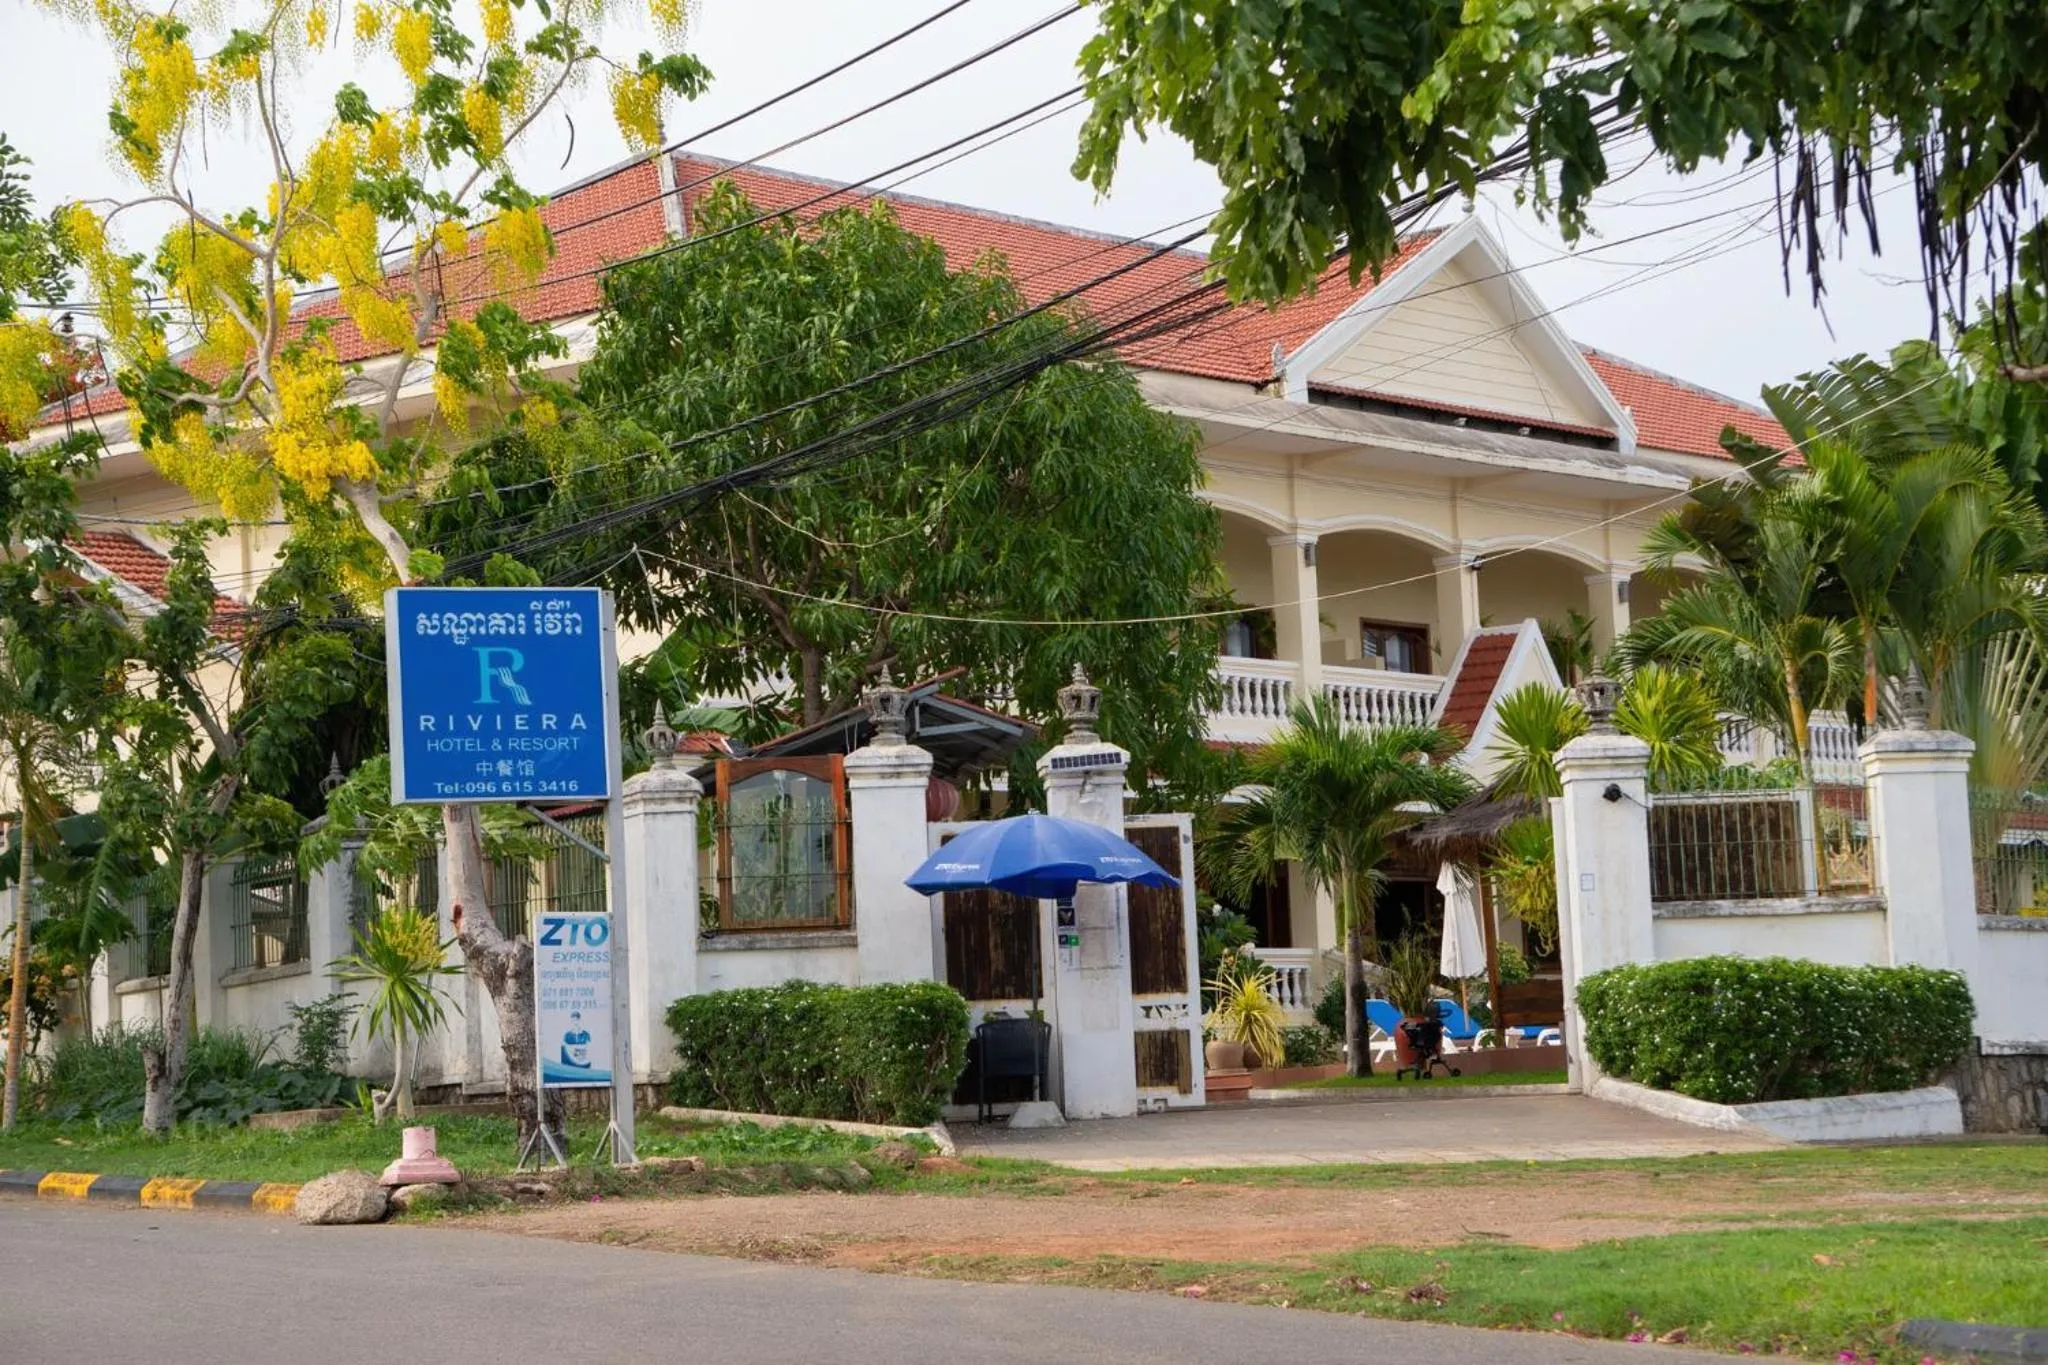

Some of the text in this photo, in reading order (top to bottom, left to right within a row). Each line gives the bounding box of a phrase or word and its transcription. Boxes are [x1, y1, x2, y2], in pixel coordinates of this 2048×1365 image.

[419, 713, 588, 732] RIVIERA
[427, 737, 580, 752] HOTEL & RESORT
[475, 758, 536, 777] 中餐馆
[434, 780, 579, 794] Tel:096 615 3416
[540, 917, 608, 947] ZTO
[552, 951, 610, 963] EXPRESS
